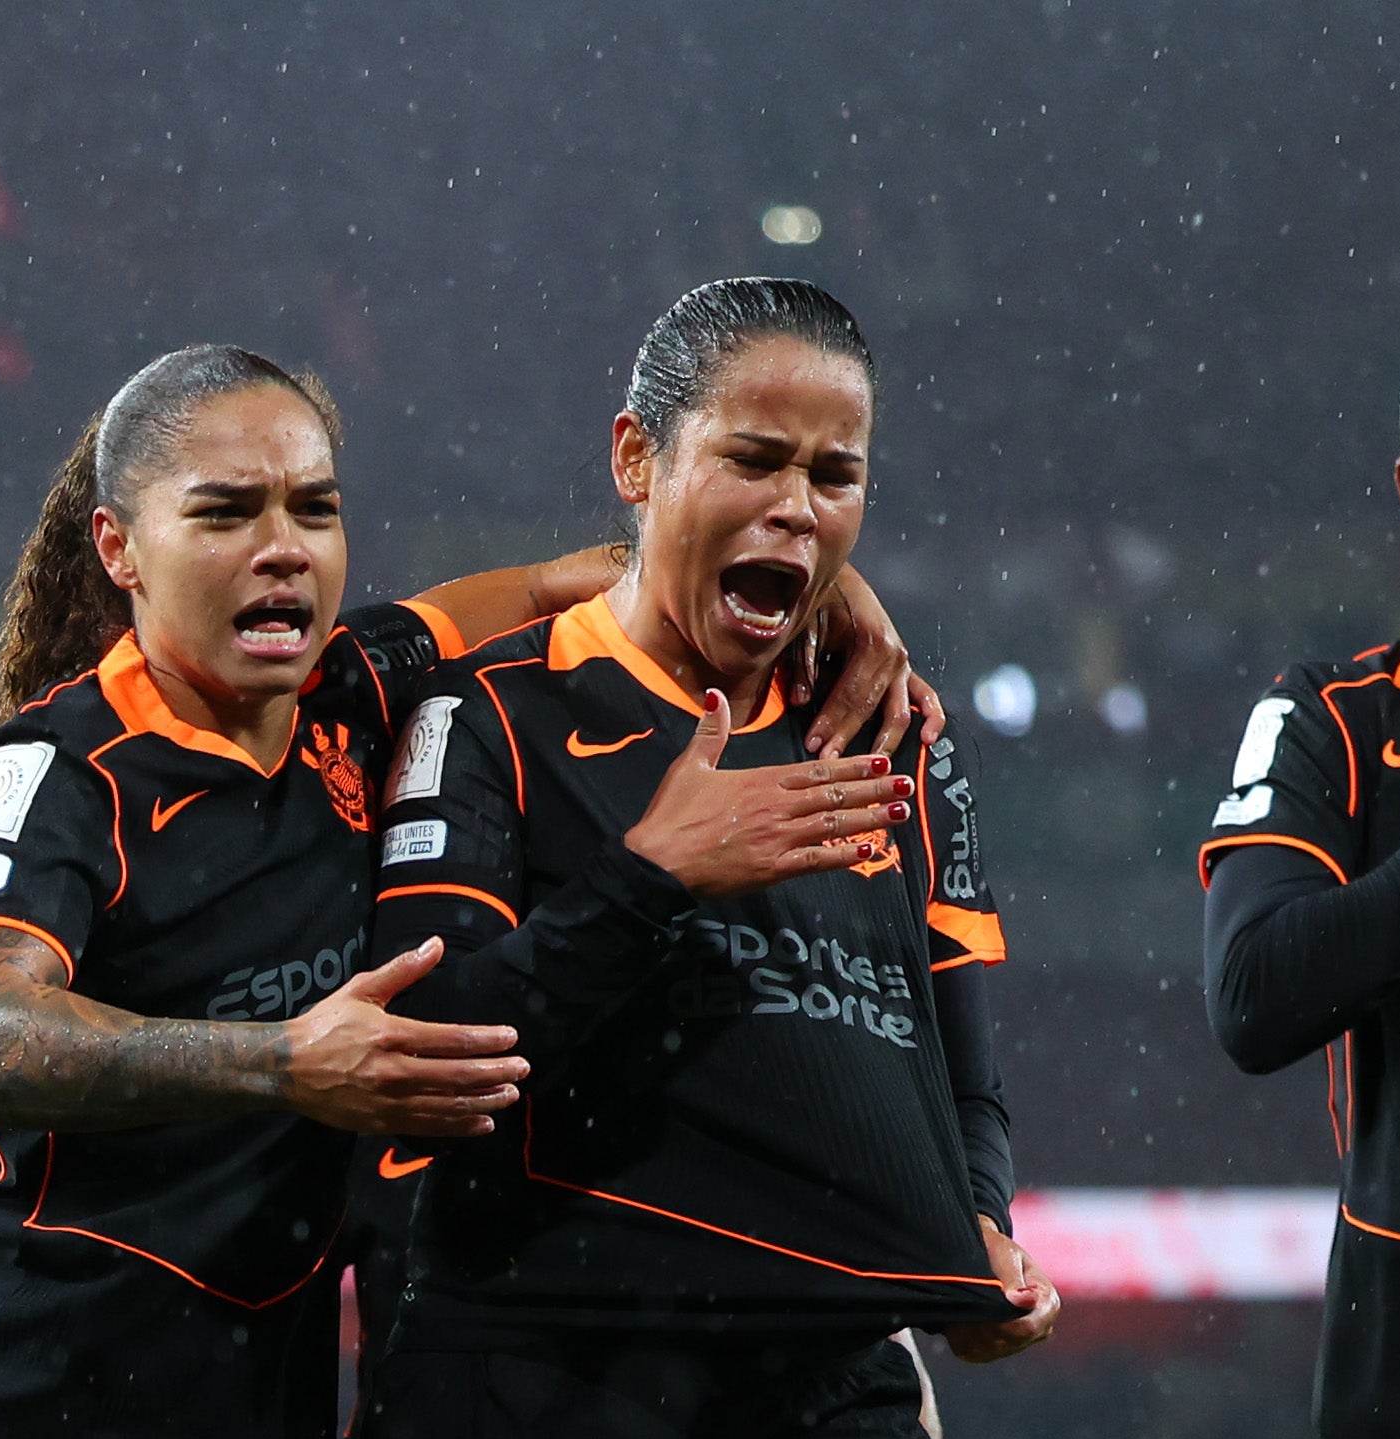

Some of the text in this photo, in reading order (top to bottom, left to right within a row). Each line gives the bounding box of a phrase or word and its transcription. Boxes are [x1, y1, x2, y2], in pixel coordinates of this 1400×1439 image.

[404, 824, 436, 841] UNITES
[942, 776, 976, 900] bmg
[410, 842, 431, 854] FIFA
